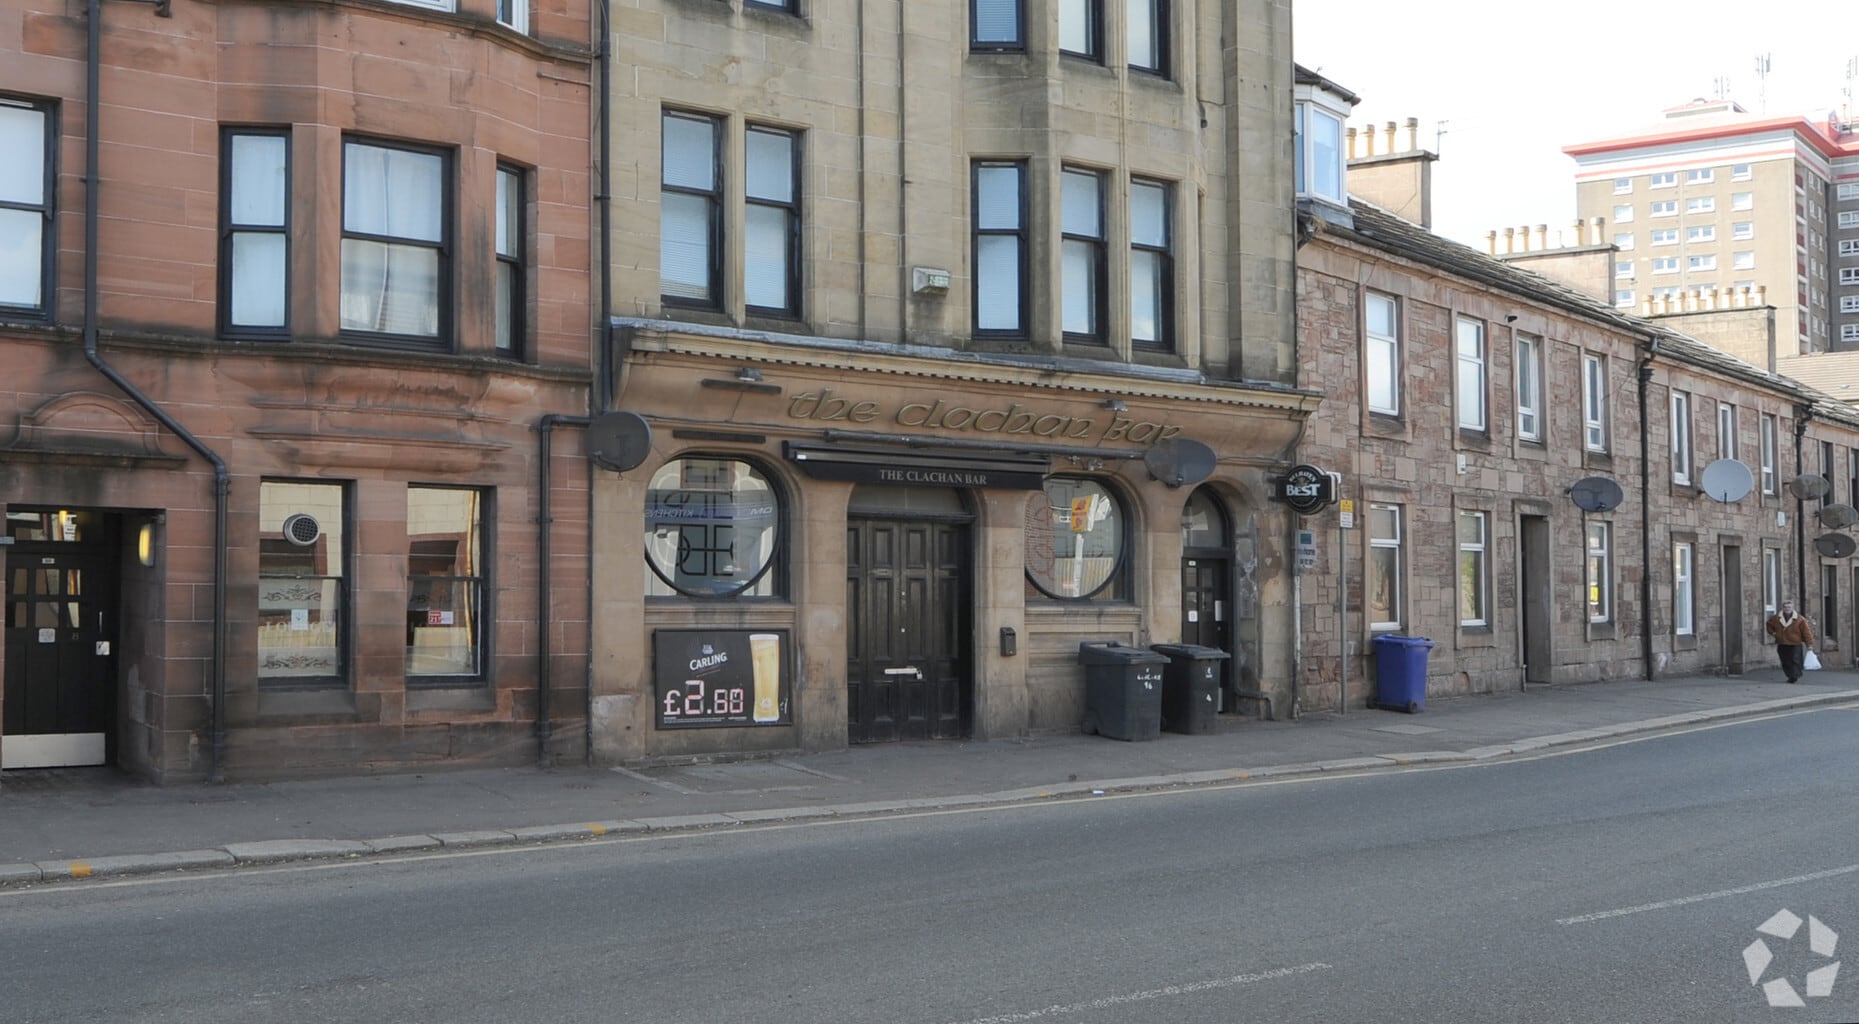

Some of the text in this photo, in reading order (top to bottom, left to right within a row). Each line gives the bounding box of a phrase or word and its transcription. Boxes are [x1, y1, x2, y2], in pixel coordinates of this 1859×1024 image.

[787, 387, 881, 423] the
[880, 469, 987, 485] THE CLACHAN BAR
[1286, 483, 1321, 496] BEST
[689, 652, 728, 671] CARLING
